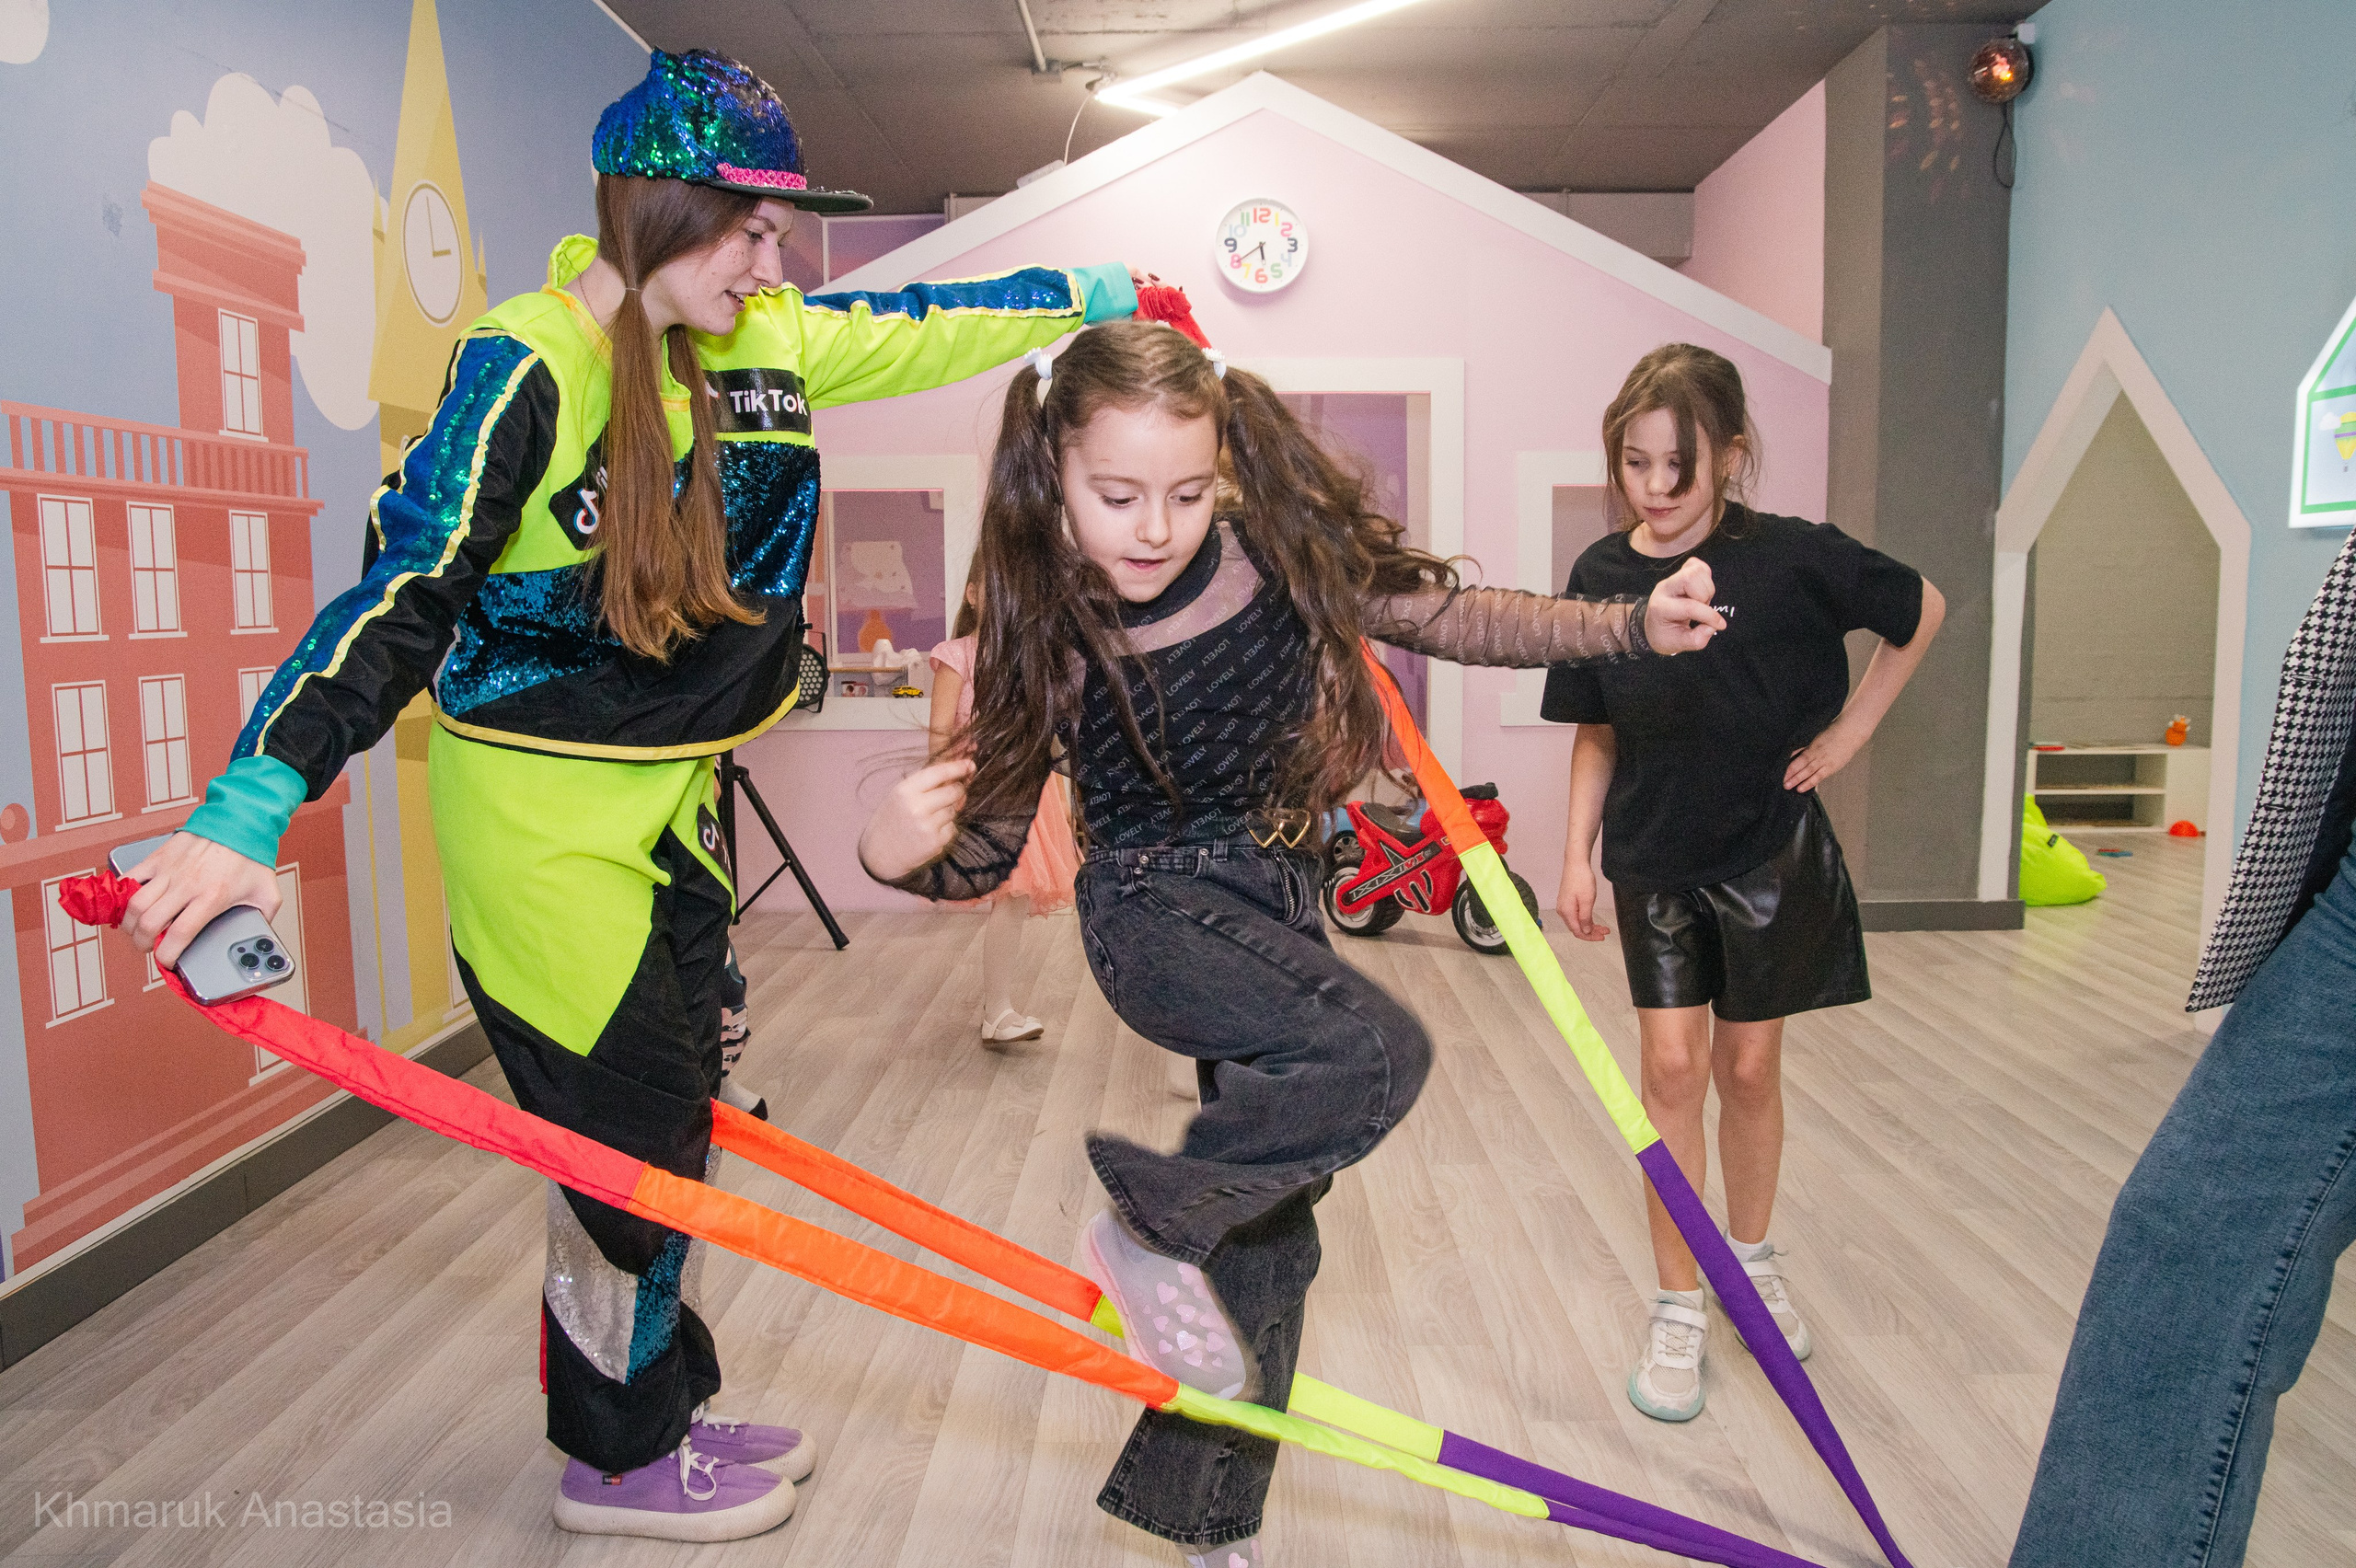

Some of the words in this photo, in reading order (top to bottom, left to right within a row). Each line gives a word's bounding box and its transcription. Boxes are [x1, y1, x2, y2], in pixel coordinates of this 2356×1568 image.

[1241, 212, 1250, 226] 11
[1253, 207, 1271, 223] 12
[1275, 212, 1279, 226] 1
[1229, 224, 1247, 237] 10
[1280, 222, 1293, 237] 2
[1224, 237, 1238, 253] 9
[1288, 237, 1298, 253] 3
[1230, 253, 1242, 269] 8
[1242, 263, 1251, 279] 7
[1270, 263, 1283, 279] 5
[1280, 253, 1292, 267] 4
[1254, 268, 1268, 283] 6
[730, 389, 808, 416] TikTok
[1235, 606, 1264, 633] LOVELY
[1553, 619, 1565, 651] LOVELY
[1166, 638, 1196, 664] LOVELY
[1201, 639, 1230, 667] LOVELY
[1242, 635, 1269, 663] LOVELY
[1165, 669, 1195, 697] LOVELY
[1206, 665, 1236, 693] LOVELY
[1247, 663, 1275, 690] LOVELY
[1171, 697, 1202, 723] LOVELY
[1251, 694, 1272, 716] OVELY
[1279, 699, 1296, 722] OVELY
[1091, 707, 1117, 731] OVELY
[1215, 718, 1240, 742] LOVEL
[1178, 719, 1207, 746] OVELY
[1247, 718, 1270, 745] LOVELY
[1093, 731, 1122, 757] LOVELY
[1214, 746, 1241, 775] LOVELY
[1218, 774, 1244, 797] LOVELY
[1088, 814, 1112, 832] OVELY
[1149, 806, 1175, 824] OVELY
[1190, 807, 1222, 830] LOVELY
[1114, 823, 1143, 844] LOVELY
